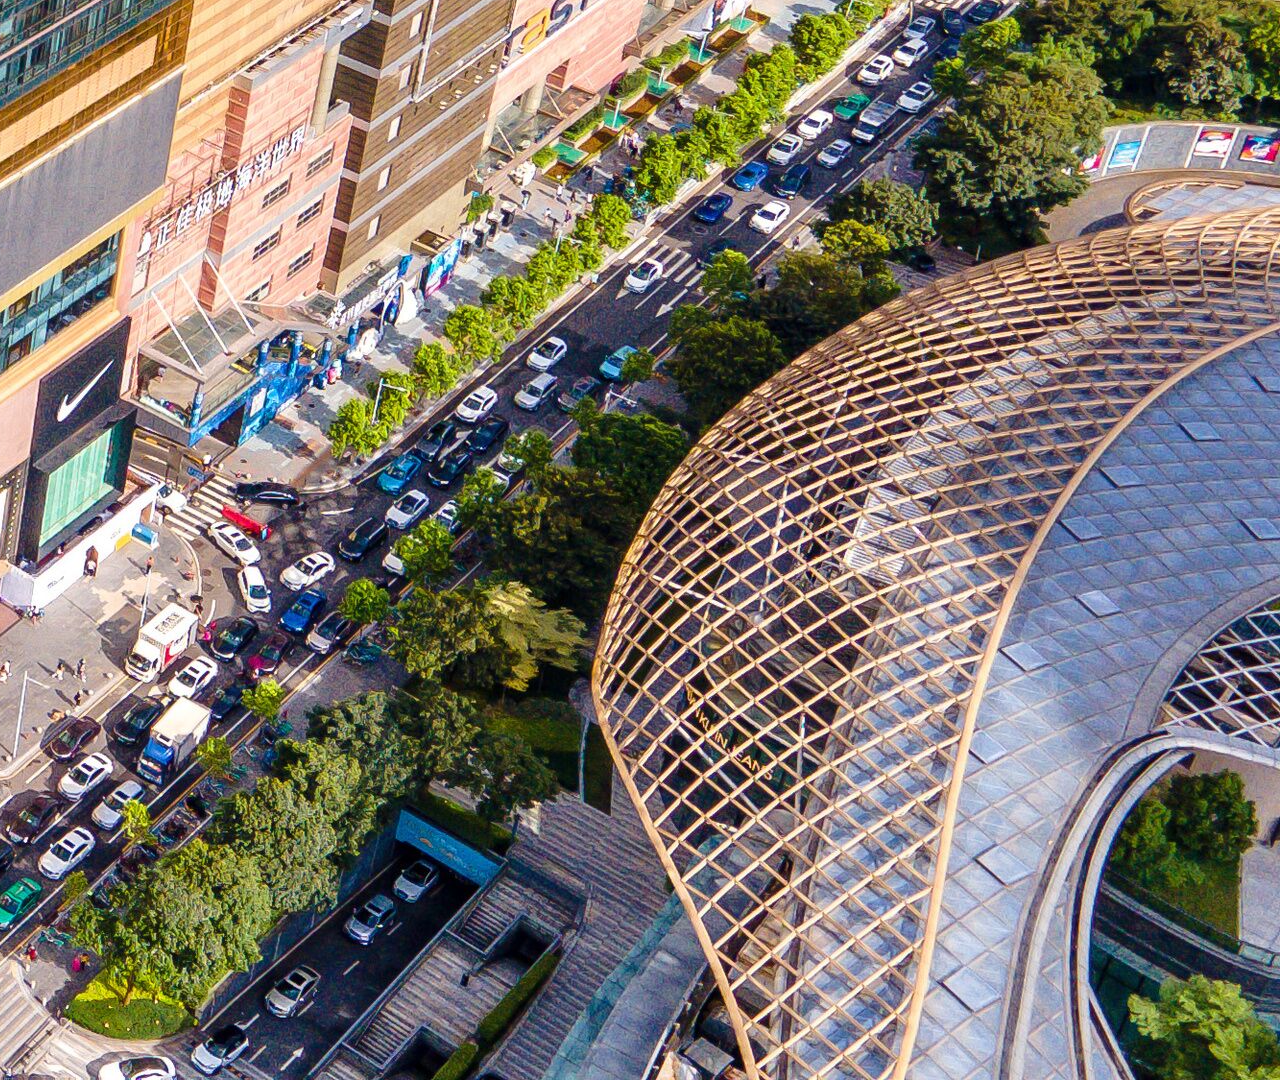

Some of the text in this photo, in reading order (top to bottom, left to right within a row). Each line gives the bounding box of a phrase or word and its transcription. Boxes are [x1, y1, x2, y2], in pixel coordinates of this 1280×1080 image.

[156, 123, 307, 250] 正佳极地海洋世界
